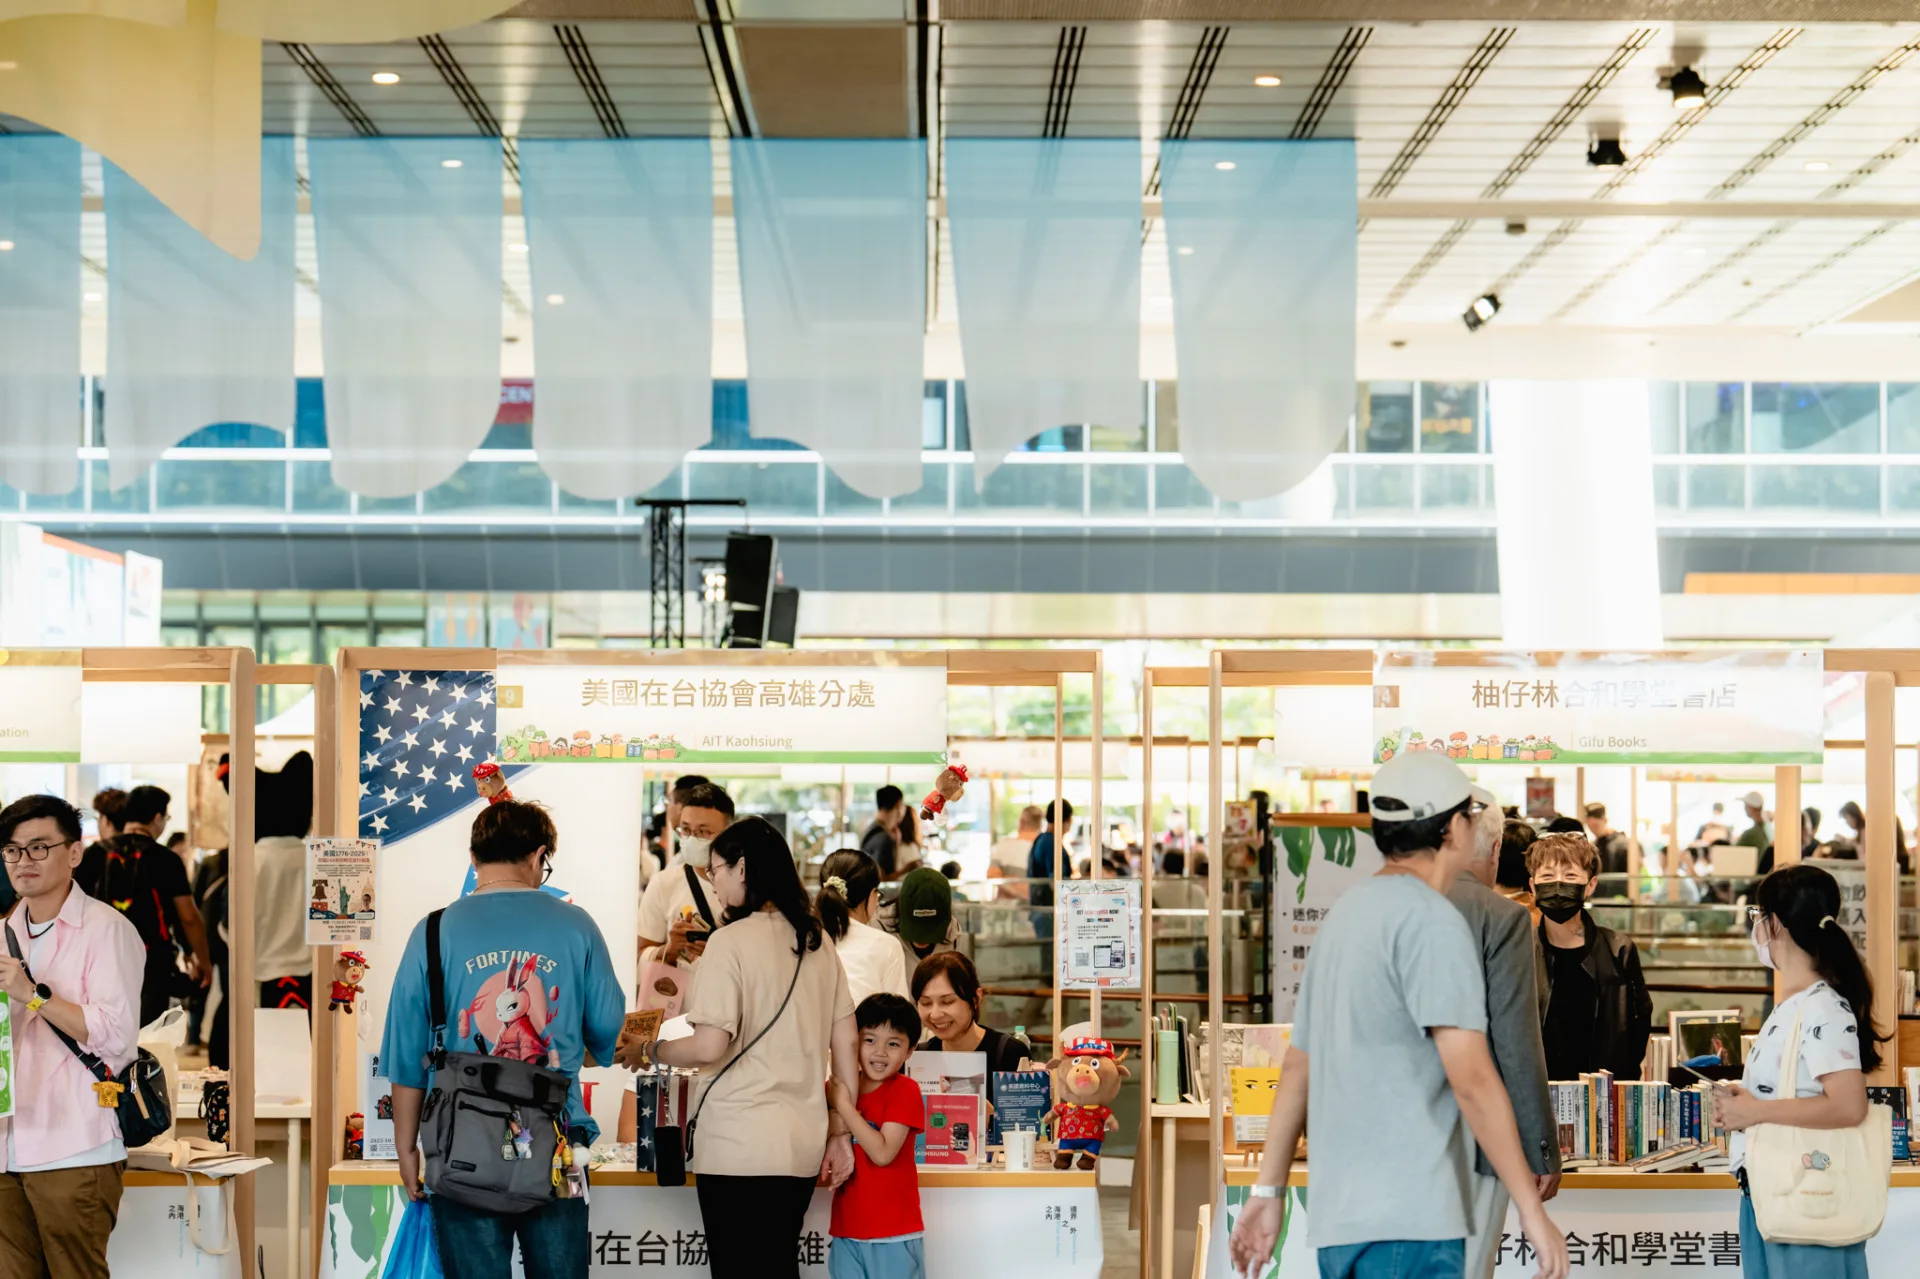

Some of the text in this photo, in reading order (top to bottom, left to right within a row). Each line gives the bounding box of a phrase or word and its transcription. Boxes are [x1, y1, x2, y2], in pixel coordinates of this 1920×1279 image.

[505, 689, 515, 704] 9
[581, 678, 876, 709] 美國在台協會高雄分處
[702, 734, 793, 750] AIT Kaohsiung
[1579, 735, 1647, 748] Gifu Books
[465, 950, 558, 975] FORTUNES
[588, 1230, 709, 1266] 在台協
